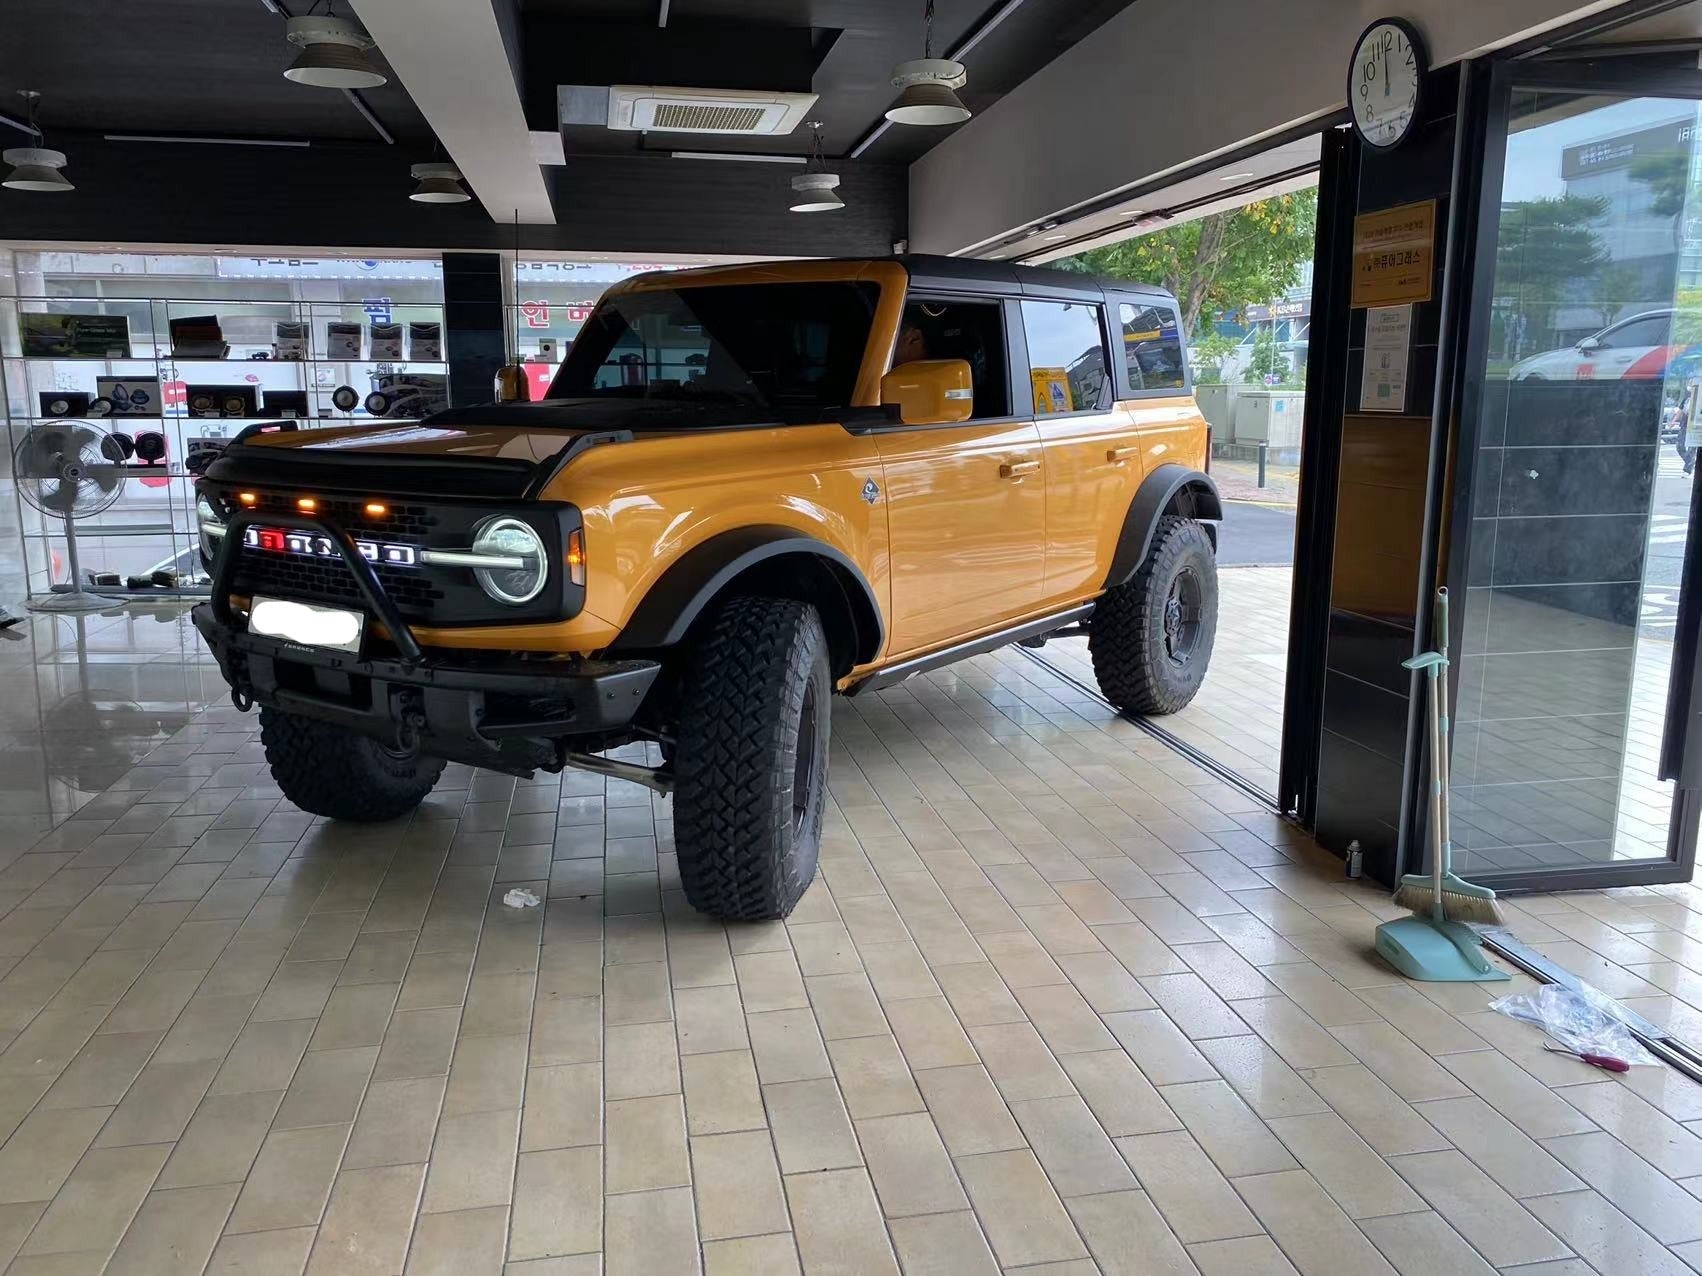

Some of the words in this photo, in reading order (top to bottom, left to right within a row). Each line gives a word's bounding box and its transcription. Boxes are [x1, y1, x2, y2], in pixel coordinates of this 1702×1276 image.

[1380, 31, 1393, 53] 12
[1397, 34, 1401, 53] 1
[1371, 42, 1380, 62] 11
[1405, 45, 1414, 66] 2
[1363, 61, 1376, 83] 10
[1360, 84, 1369, 102] 9
[1366, 104, 1374, 123] 8
[1399, 111, 1409, 129] 5
[1387, 121, 1397, 139] 6
